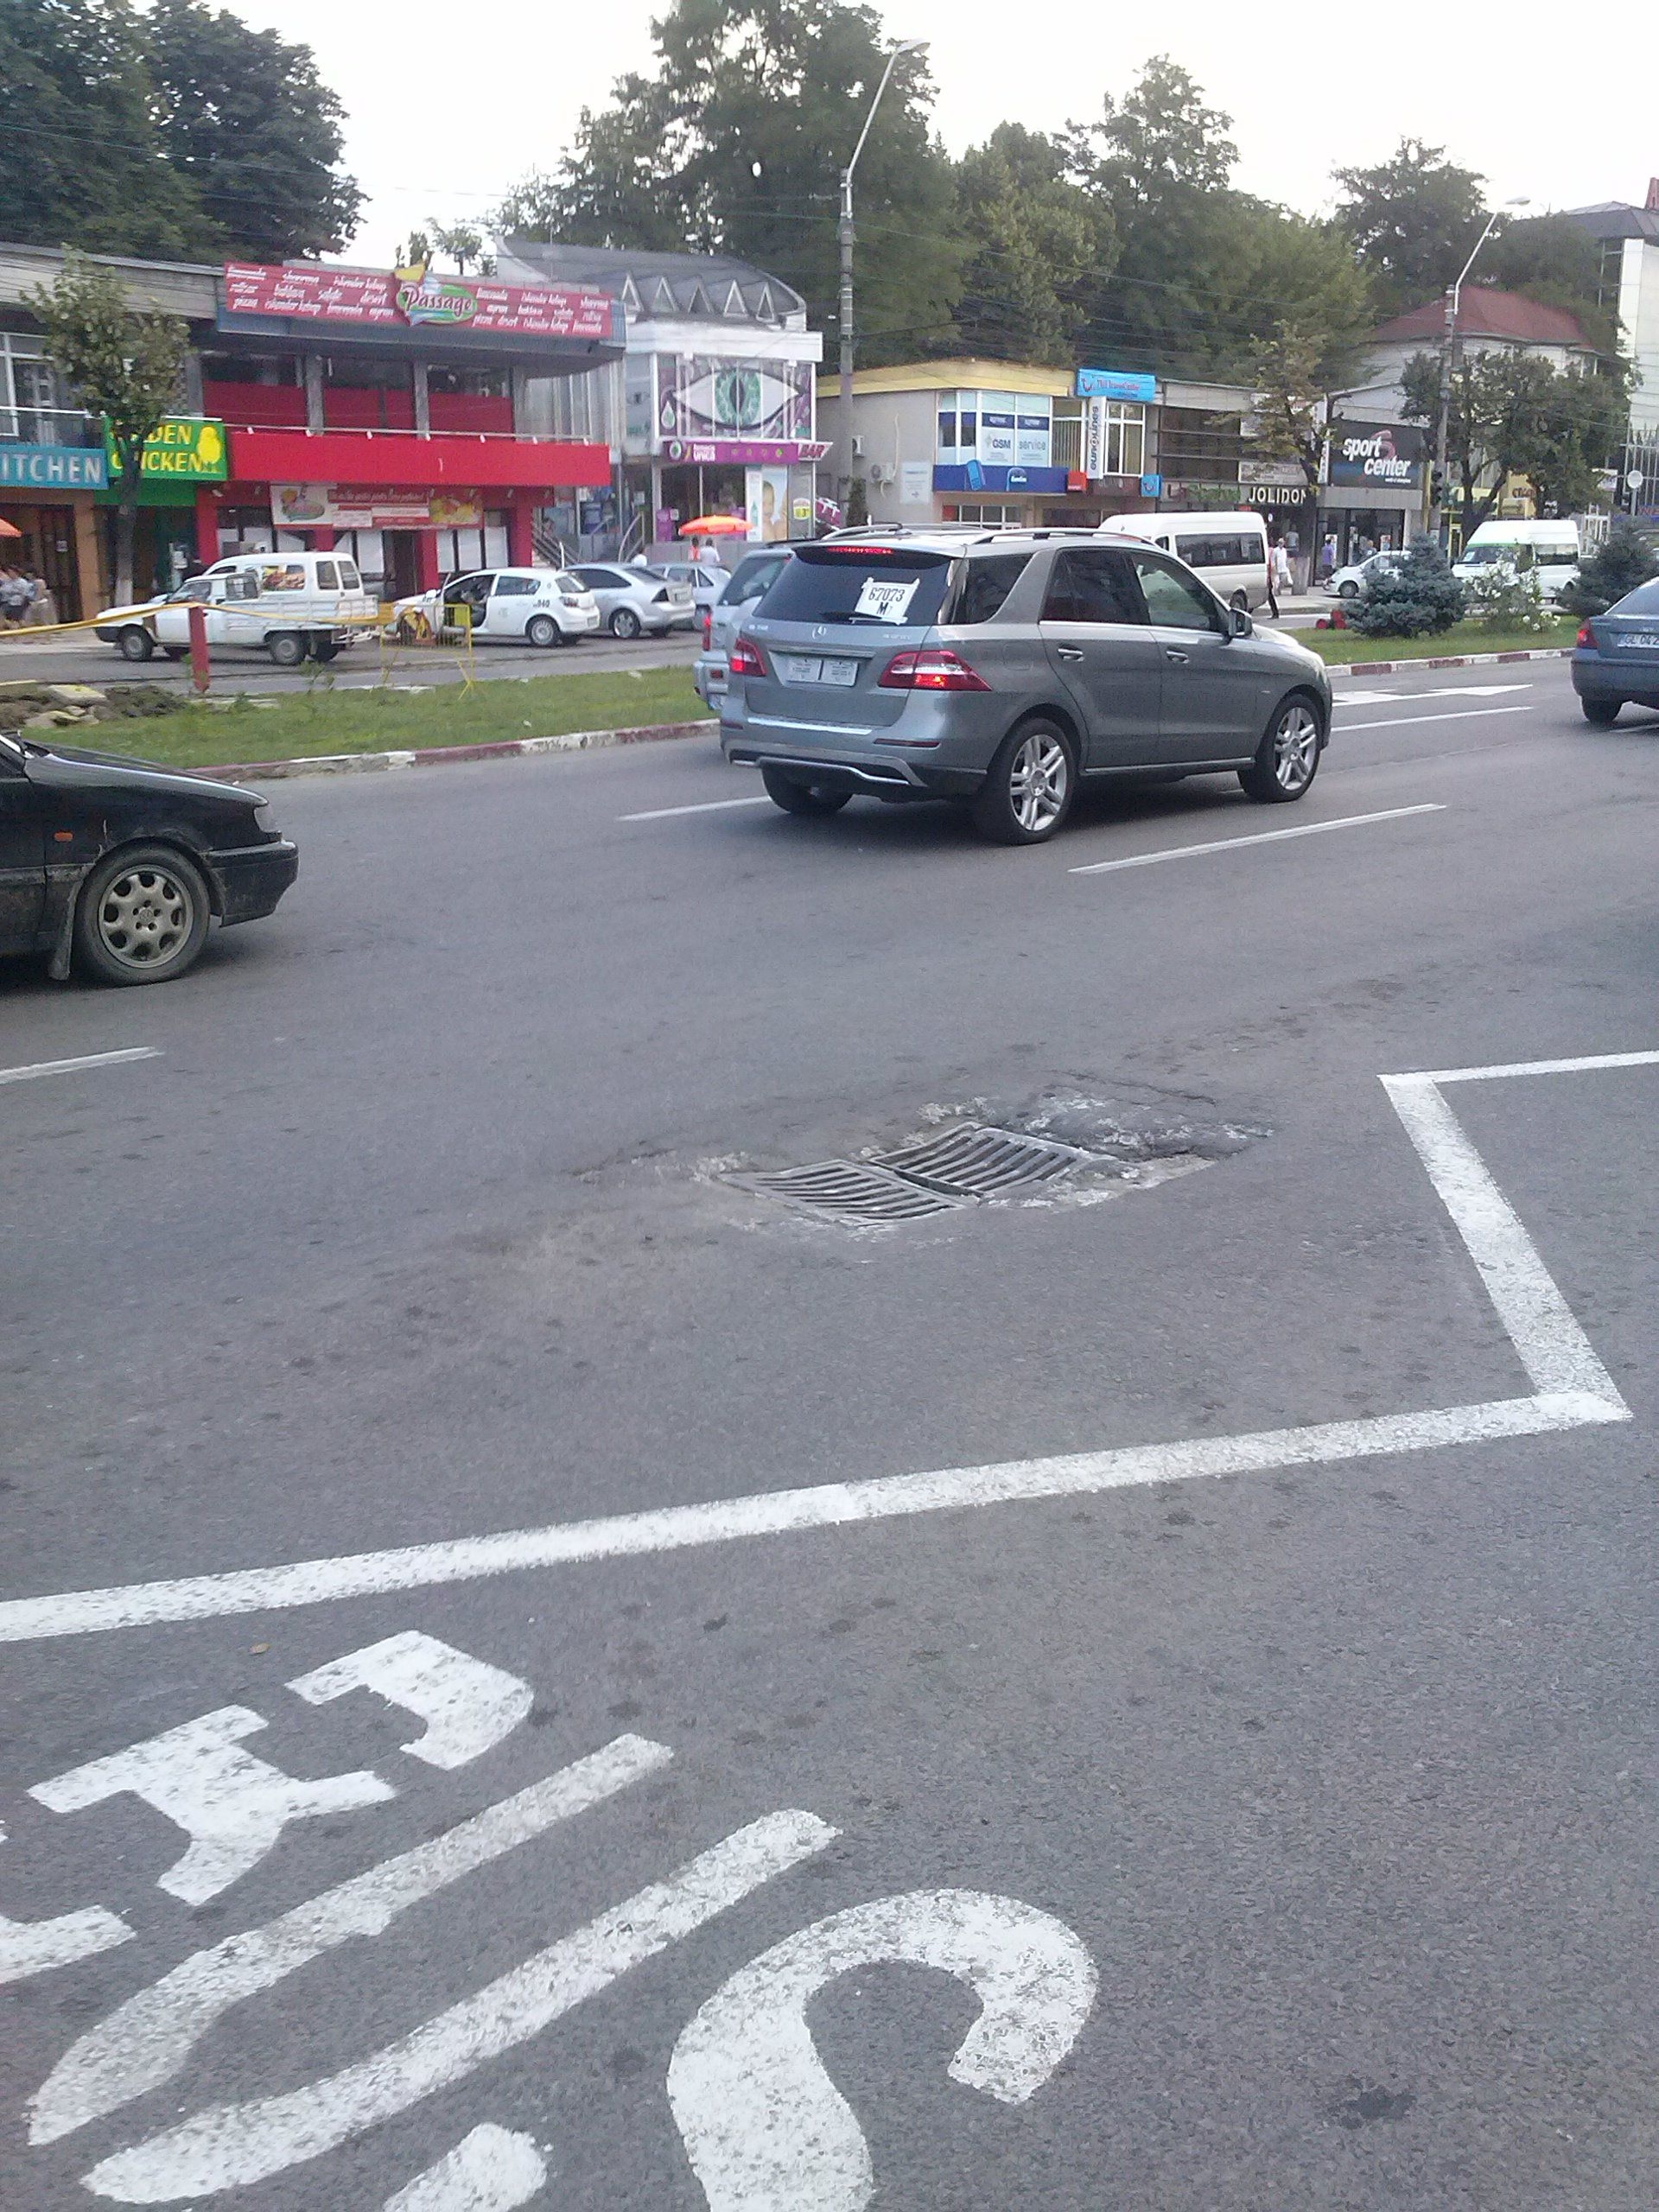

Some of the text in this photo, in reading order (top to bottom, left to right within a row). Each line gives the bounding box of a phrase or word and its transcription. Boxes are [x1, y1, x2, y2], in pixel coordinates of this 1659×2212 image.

[402, 283, 473, 318] Passage
[992, 439, 1012, 449] GSM
[1019, 442, 1046, 451] service
[1343, 436, 1382, 461] sport
[1364, 456, 1411, 476] center
[868, 588, 906, 602] 67073
[876, 602, 889, 615] M
